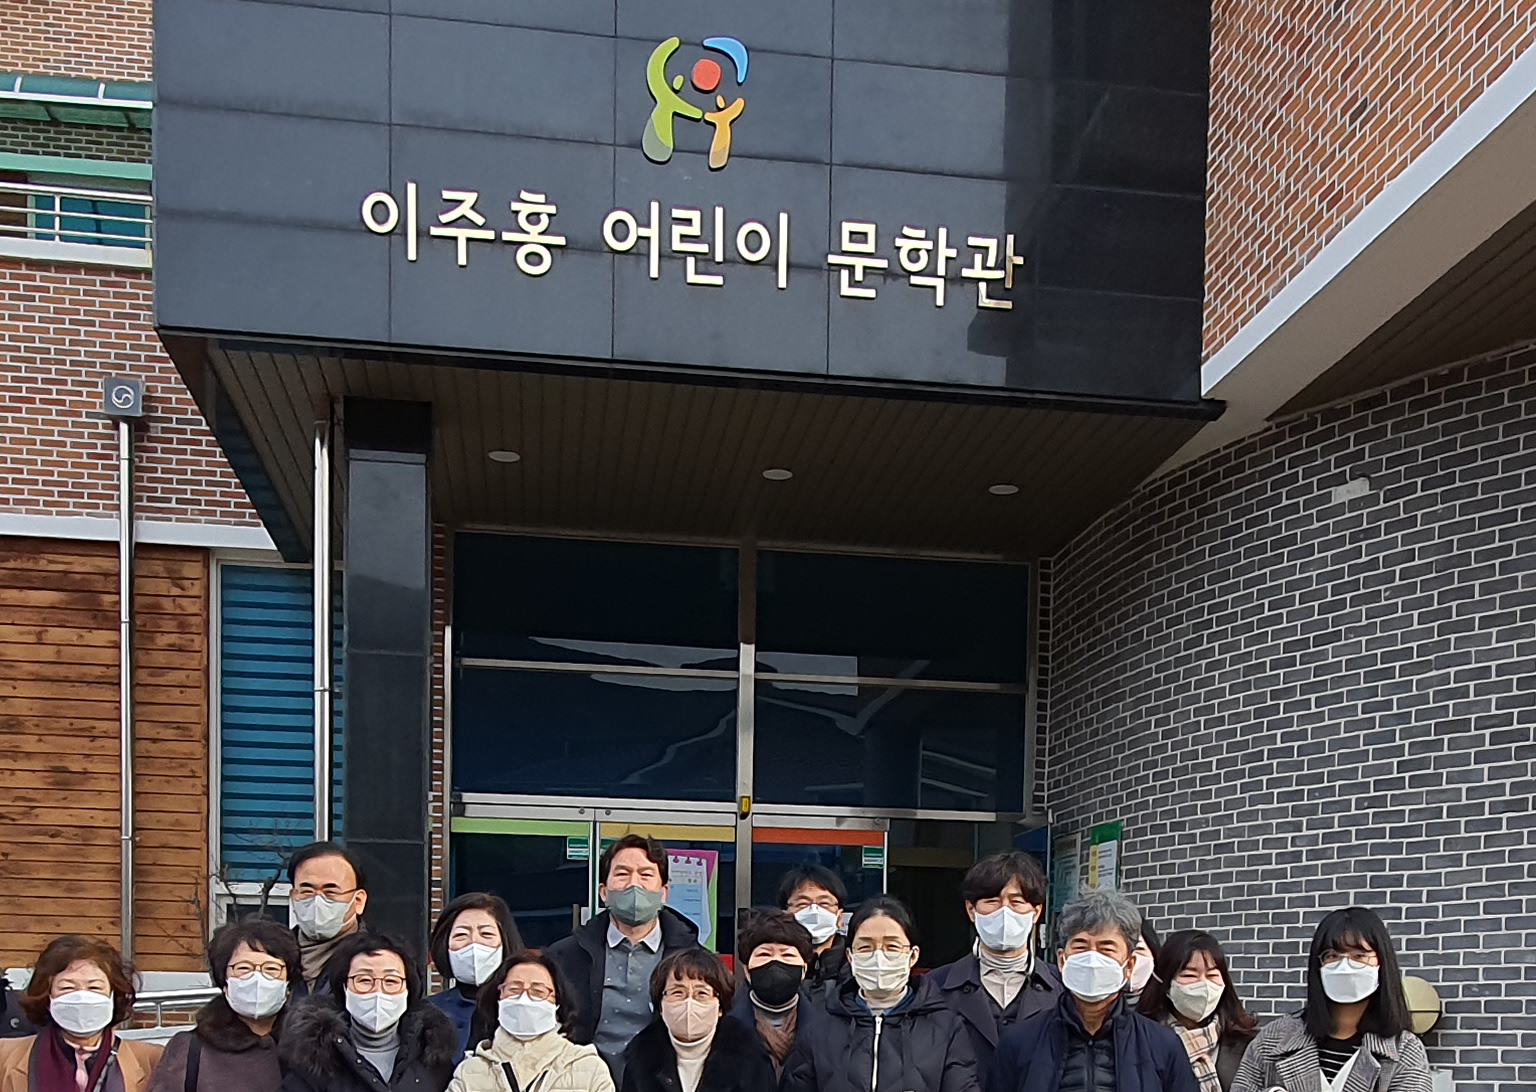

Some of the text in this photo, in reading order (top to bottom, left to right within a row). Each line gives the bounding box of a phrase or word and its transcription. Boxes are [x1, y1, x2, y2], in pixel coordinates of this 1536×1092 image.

[360, 181, 1025, 310] 이주홍 어린이 문학관
